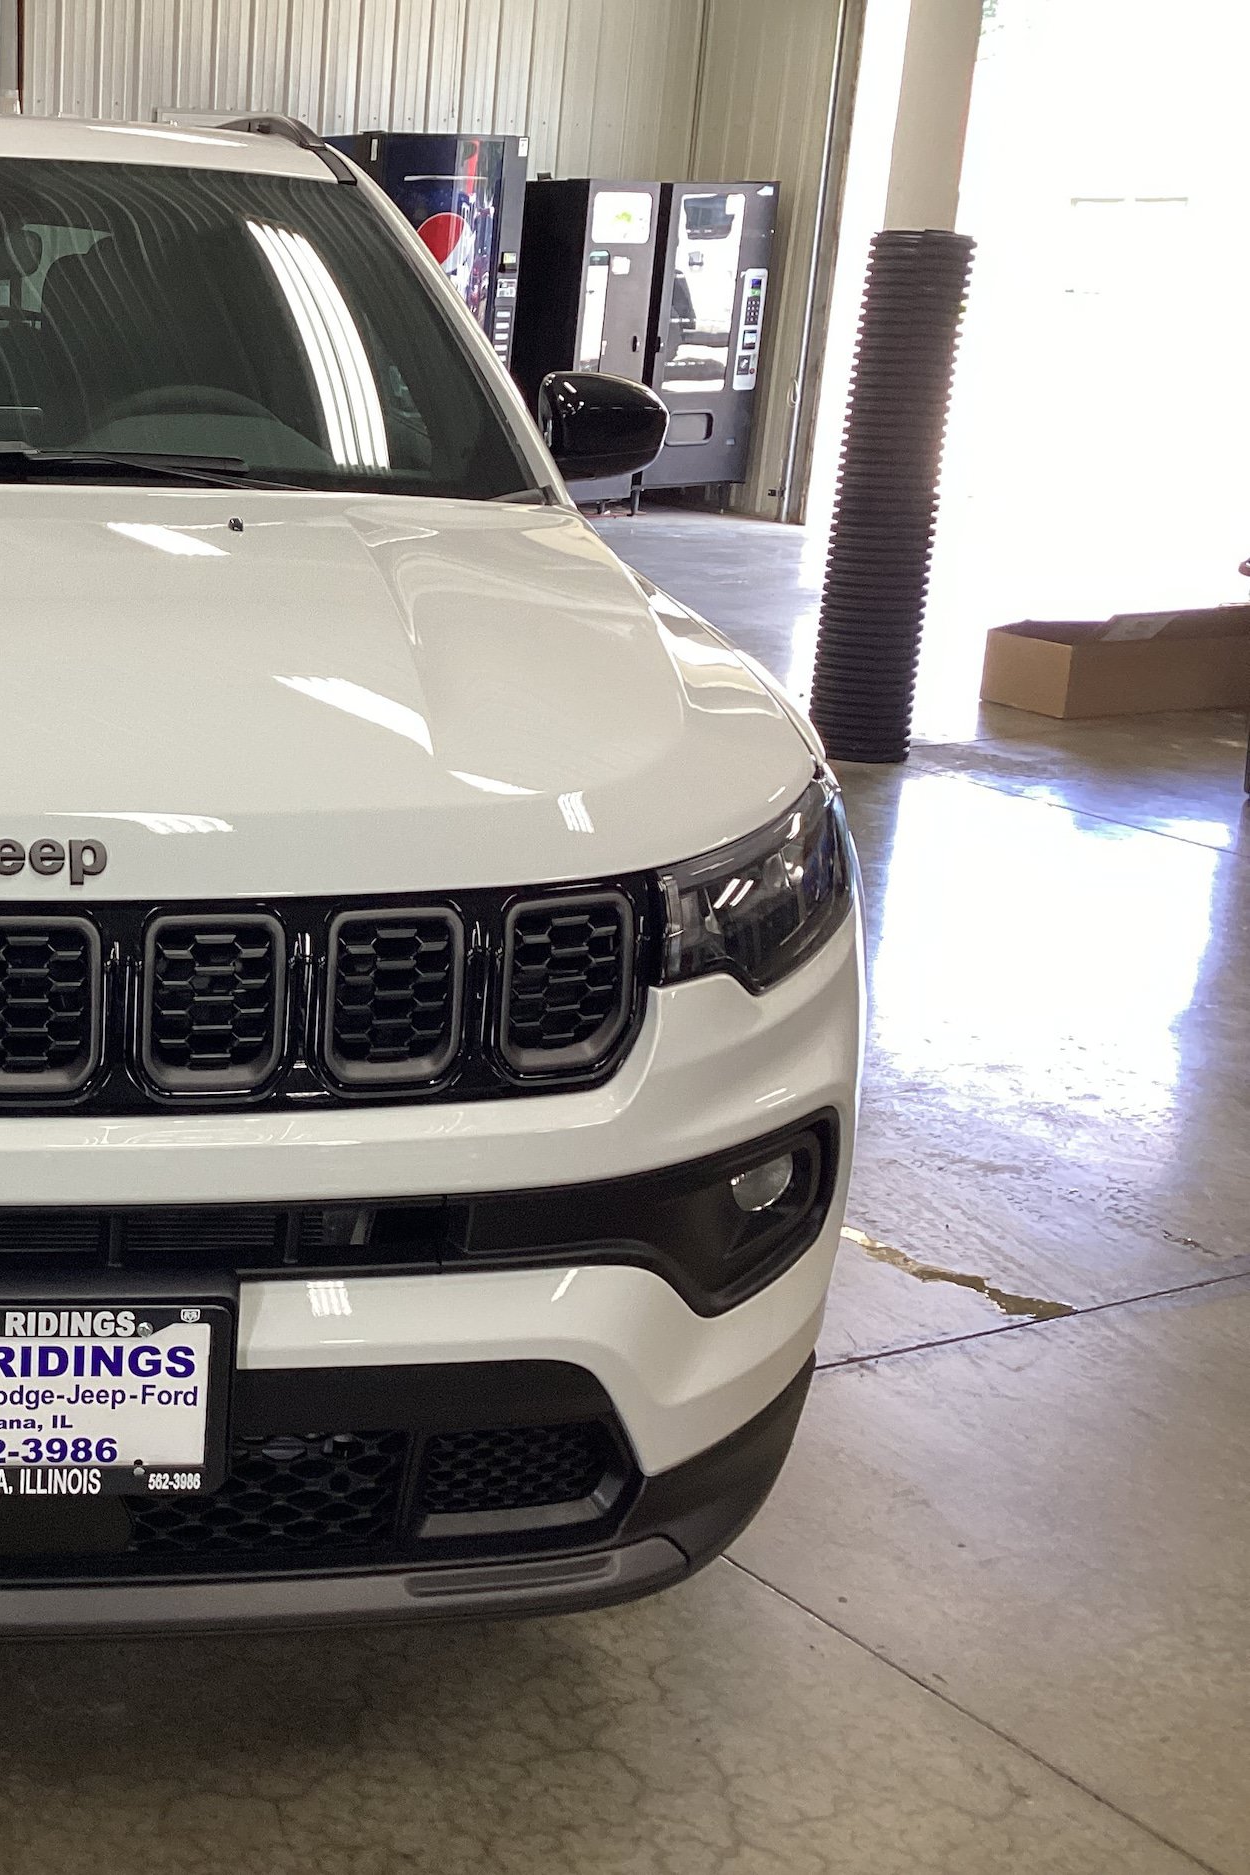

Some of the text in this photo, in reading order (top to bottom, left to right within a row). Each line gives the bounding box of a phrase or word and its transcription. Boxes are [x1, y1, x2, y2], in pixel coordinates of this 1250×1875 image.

[5, 1311, 135, 1337] RIDINGS
[52, 1415, 73, 1429] IL
[19, 1468, 101, 1495] ILLINOIS
[148, 1473, 201, 1490] 562-3986
